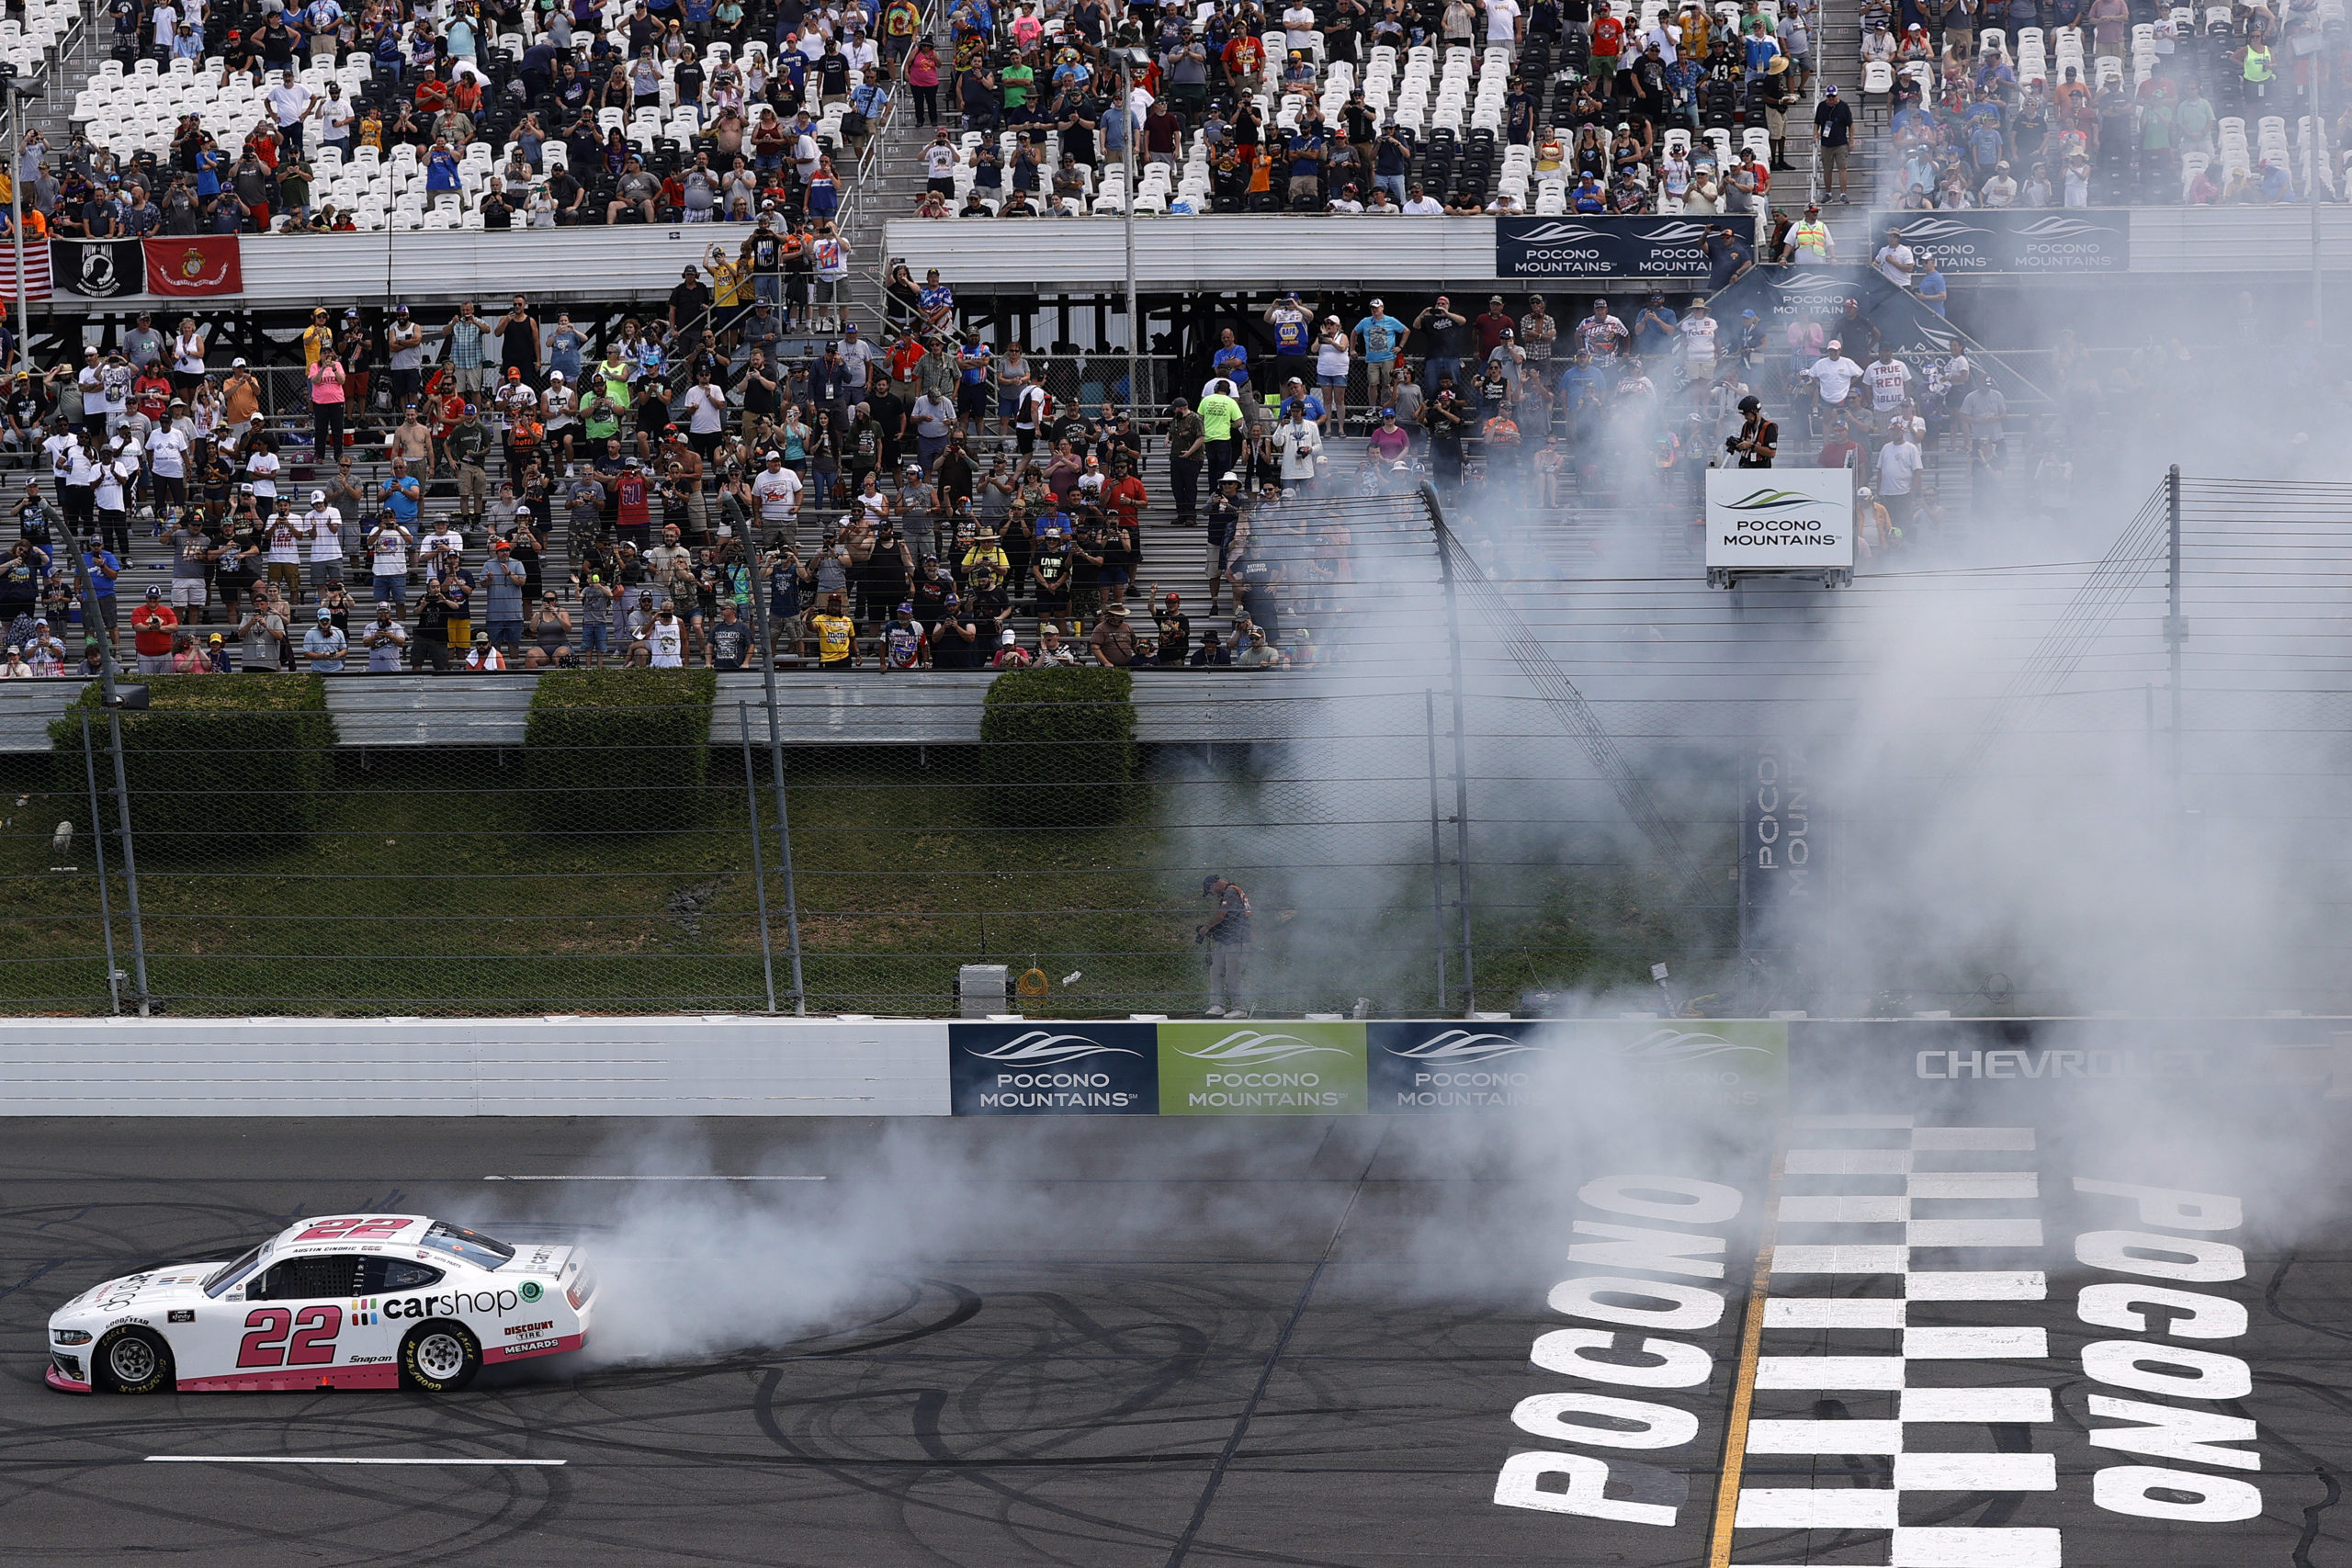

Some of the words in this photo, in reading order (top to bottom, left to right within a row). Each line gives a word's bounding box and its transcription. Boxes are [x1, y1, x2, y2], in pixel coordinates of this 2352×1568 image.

[1711, 65, 1728, 81] 43
[82, 244, 96, 263] POW
[101, 243, 114, 264] MIA
[1526, 249, 1600, 260] POCONO
[1651, 249, 1710, 259] POCON
[1912, 244, 1974, 254] OCONO
[2027, 243, 2099, 254] POCONO
[1515, 261, 1611, 272] MOUNTAINS
[1640, 261, 1713, 272] MOUNTAI
[2015, 256, 2111, 266] MOUNTAINS
[1783, 296, 1844, 304] POCONO
[1282, 327, 1296, 335] NAPA
[1873, 366, 1901, 375] TRUE
[1875, 377, 1901, 388] RED
[1736, 521, 1821, 531] POCONO
[1724, 536, 1835, 546] MOUNTAINS
[1758, 746, 1780, 869] POCO
[997, 1073, 1110, 1088] POCONO
[1205, 1073, 1320, 1088] POCONO
[1415, 1073, 1529, 1088] POCONO
[979, 1092, 1129, 1107] MOUNTAINS
[1188, 1092, 1339, 1107] MOUNTAINS
[293, 1218, 414, 1240] 22
[447, 1260, 461, 1269] PARTS
[382, 1289, 518, 1319] carshop
[106, 1315, 149, 1330] GOODYEAR
[504, 1320, 554, 1336] DISCOUNT
[102, 1326, 127, 1347] EAGLE
[235, 1305, 343, 1369] 22
[519, 1331, 541, 1339] TIRE
[457, 1331, 474, 1360] EAGLE
[504, 1338, 560, 1355] MENARDS
[1494, 1173, 1743, 1527] POCONO
[2073, 1177, 2263, 1523] POCONO
[349, 1354, 391, 1365] Snap-on
[406, 1340, 442, 1391] GOODYEAR
